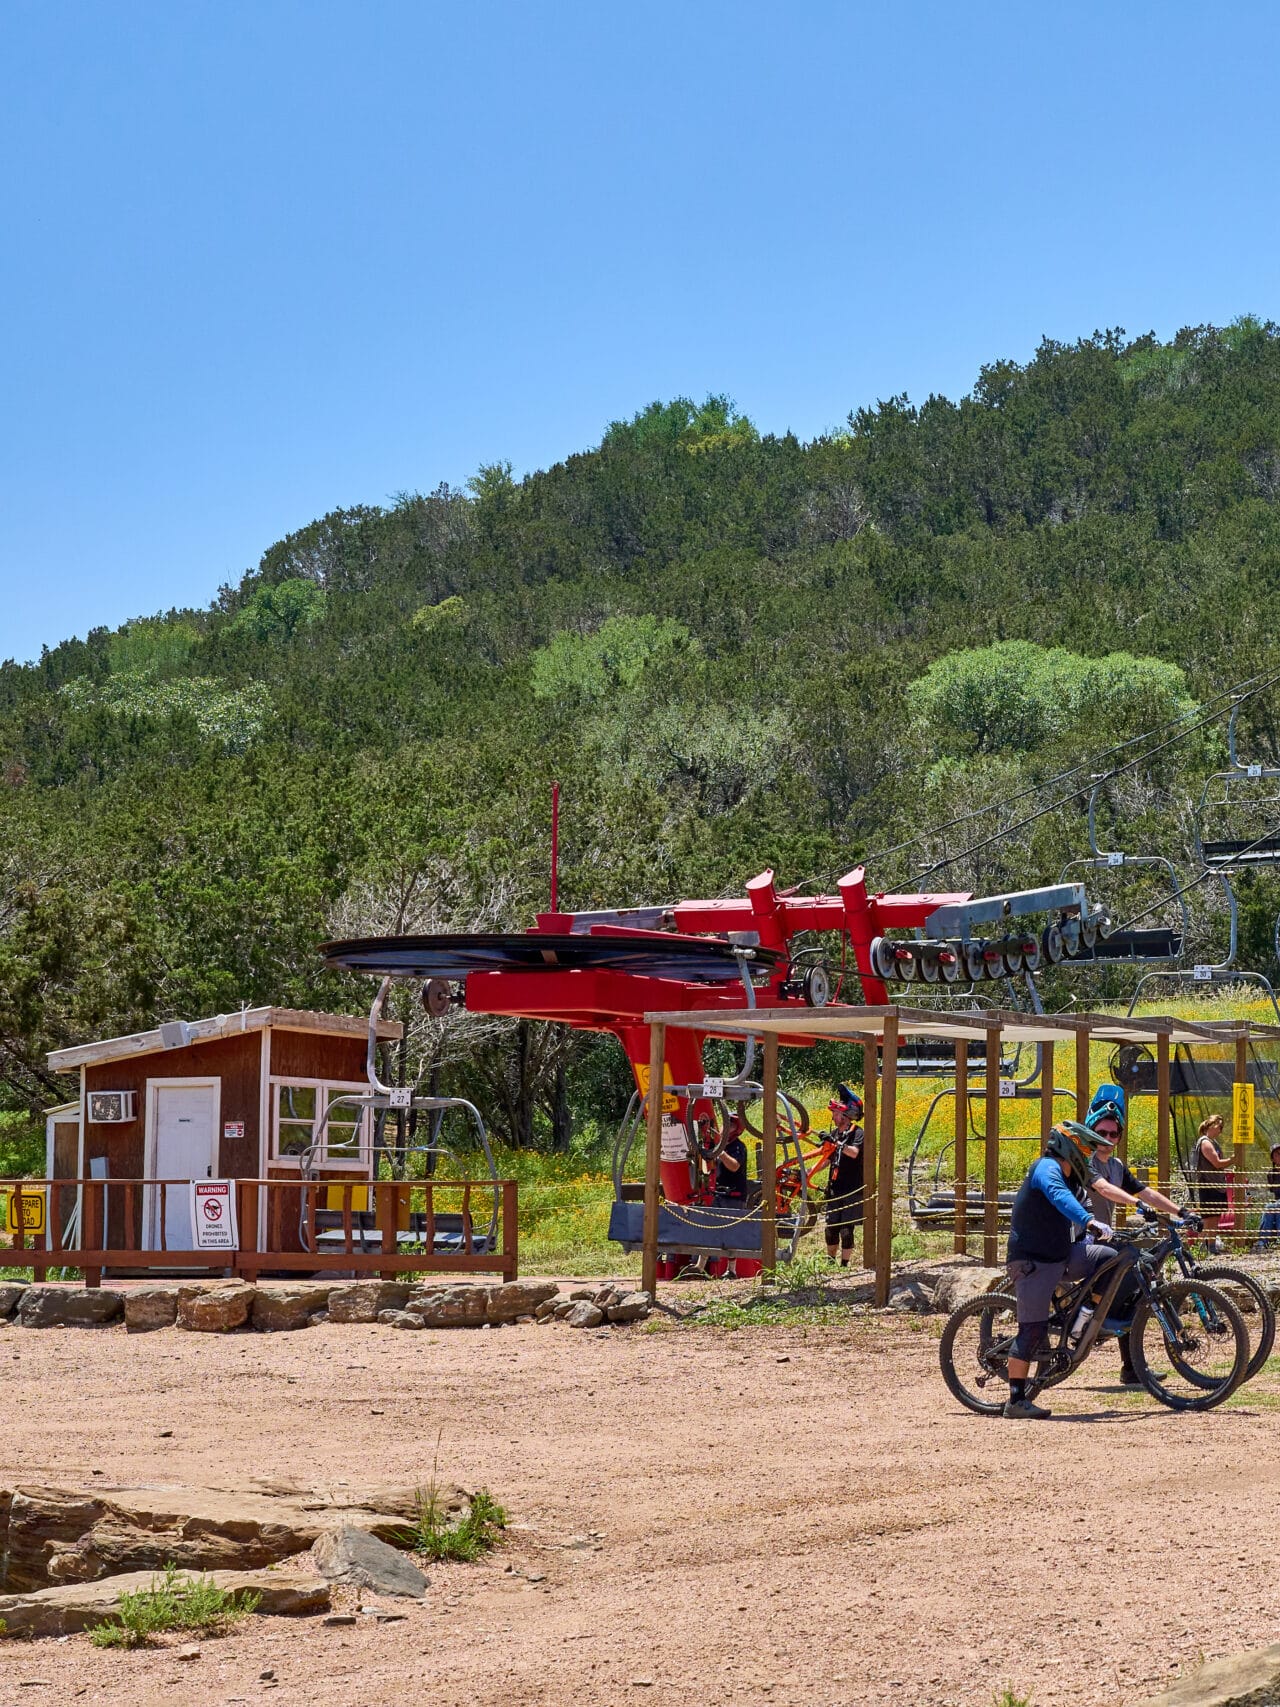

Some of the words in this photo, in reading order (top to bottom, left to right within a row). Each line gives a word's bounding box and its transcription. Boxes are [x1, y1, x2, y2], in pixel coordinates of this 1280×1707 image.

[709, 1085, 717, 1095] 28
[1001, 1086, 1010, 1095] 29
[396, 1095, 405, 1104] 27
[197, 1186, 227, 1194] WARNING
[22, 1199, 39, 1208] EPARE
